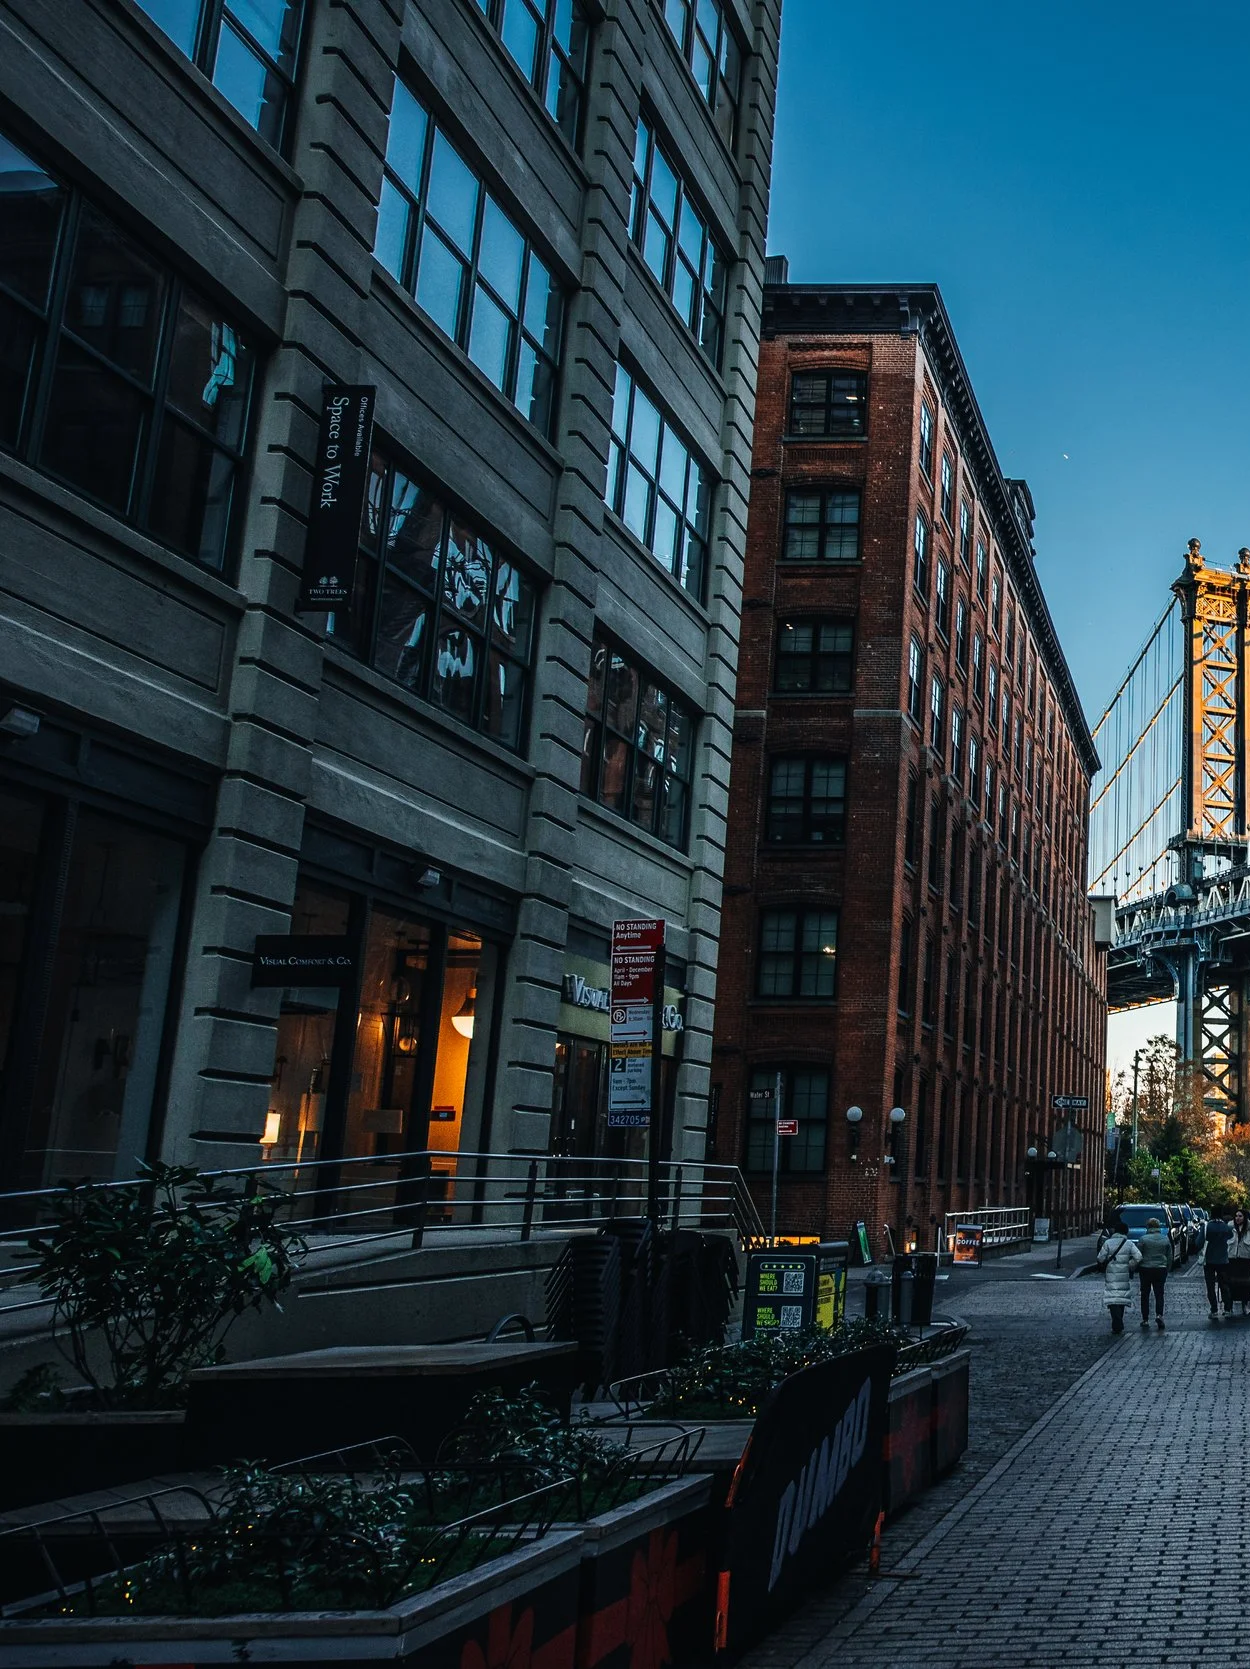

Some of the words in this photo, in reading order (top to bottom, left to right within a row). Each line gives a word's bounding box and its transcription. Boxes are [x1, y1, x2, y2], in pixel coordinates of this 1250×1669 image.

[360, 396, 369, 422] Offices
[326, 396, 350, 439] Space
[354, 423, 366, 457] Available
[326, 444, 341, 459] to
[320, 463, 342, 509] Work
[616, 923, 625, 931] NO
[626, 922, 657, 931] STANDING
[624, 955, 655, 963] STANDING
[614, 1058, 622, 1071] 2
[764, 1090, 770, 1098] St
[610, 1115, 640, 1125] 342705
[767, 1376, 871, 1593] DUMBO
